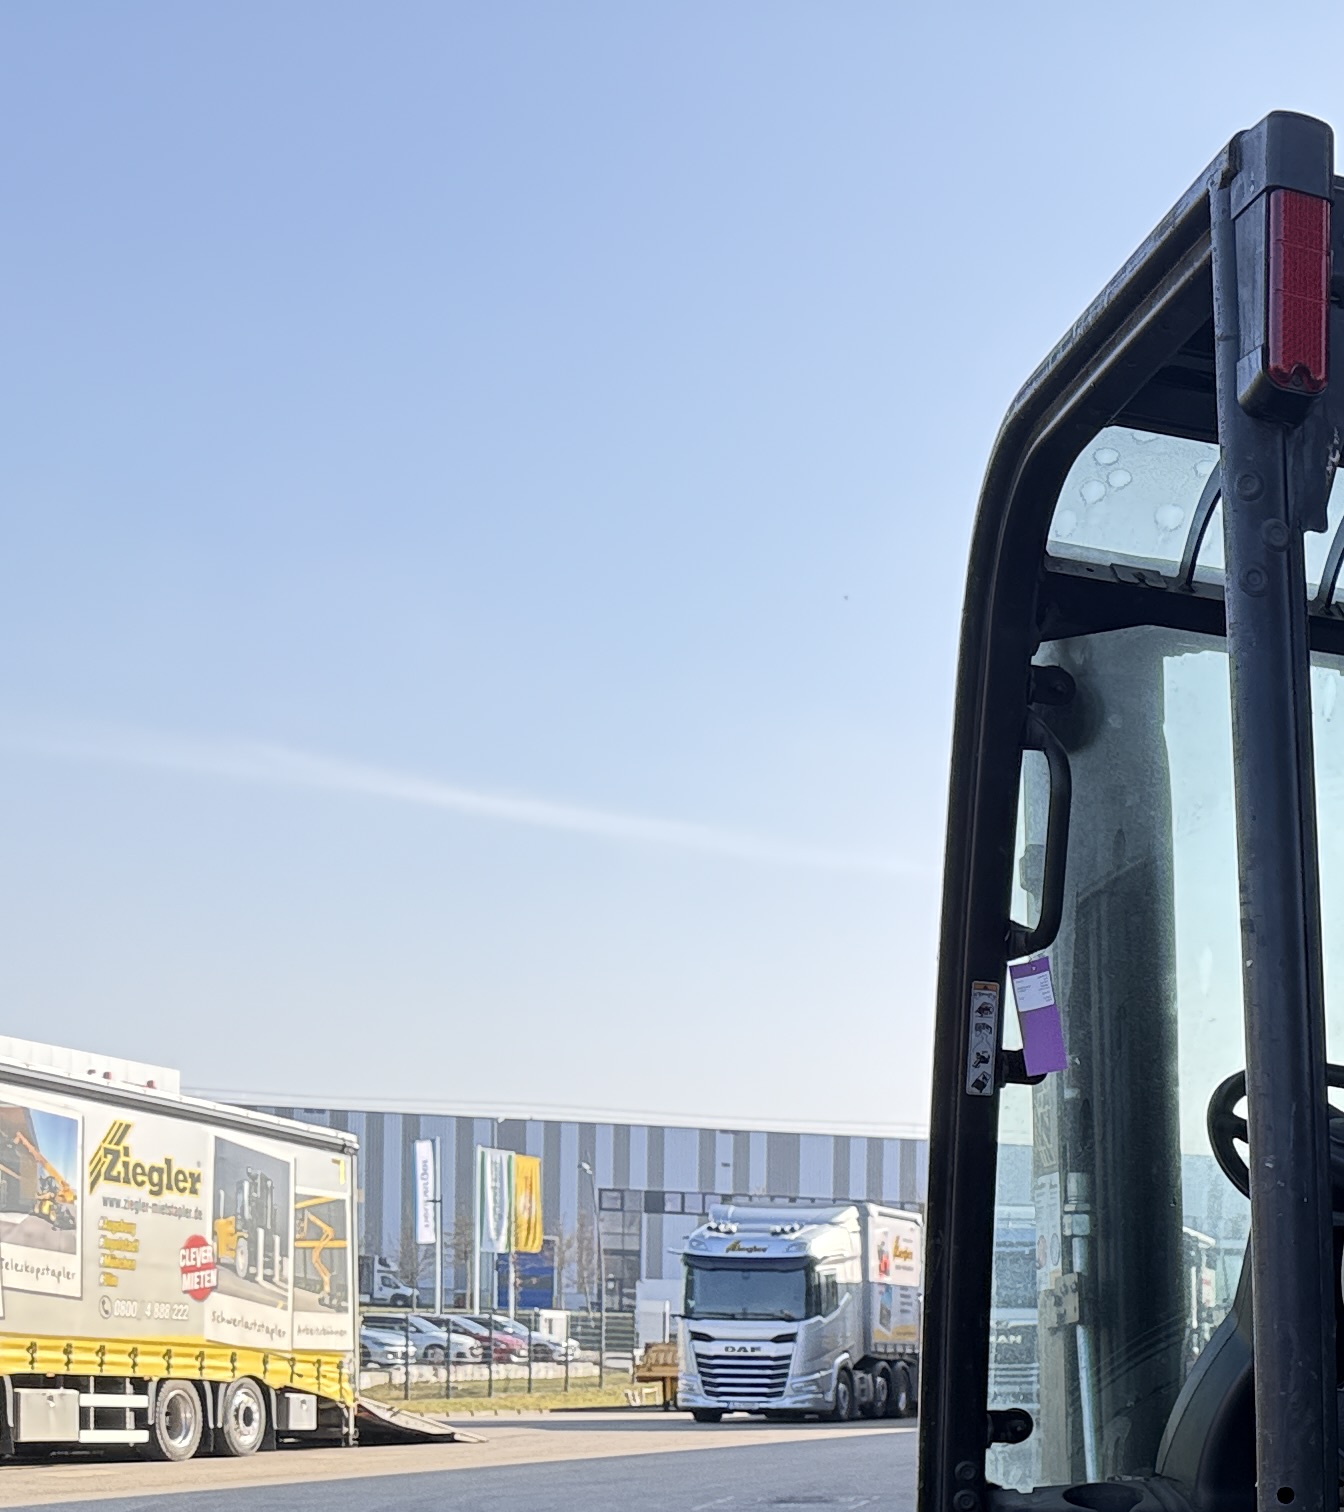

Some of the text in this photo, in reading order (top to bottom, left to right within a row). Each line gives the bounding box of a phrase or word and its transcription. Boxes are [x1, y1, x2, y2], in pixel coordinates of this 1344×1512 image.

[102, 1145, 202, 1197] Ziegler
[179, 1245, 214, 1268] CLEVER
[181, 1268, 217, 1293] MIETEN
[172, 1303, 189, 1321] 222
